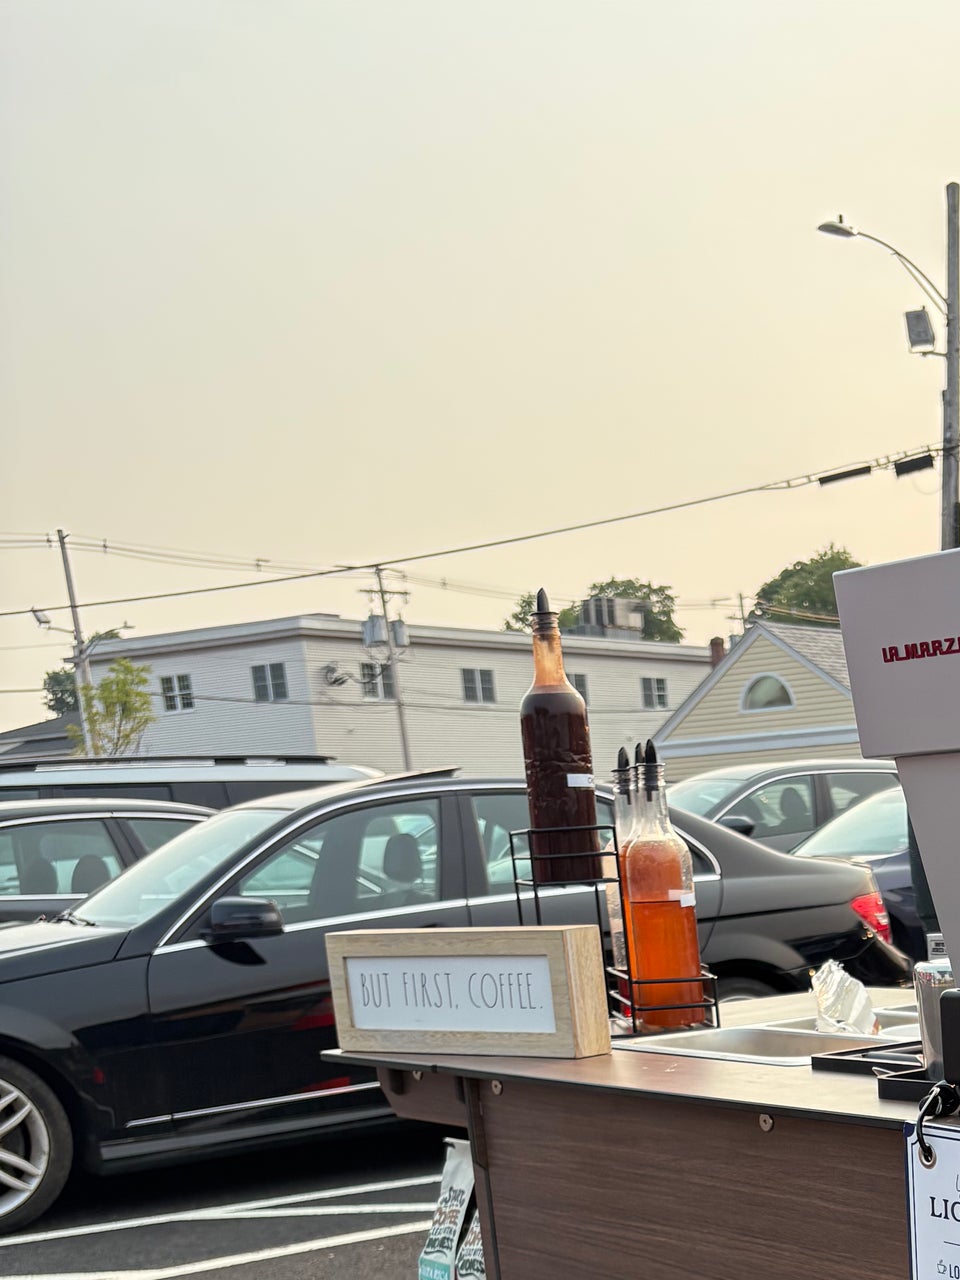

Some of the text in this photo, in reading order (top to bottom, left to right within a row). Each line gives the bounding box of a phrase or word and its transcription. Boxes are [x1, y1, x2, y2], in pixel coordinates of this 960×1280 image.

[360, 972, 544, 1010] BUT FIRST, COFFEE.
